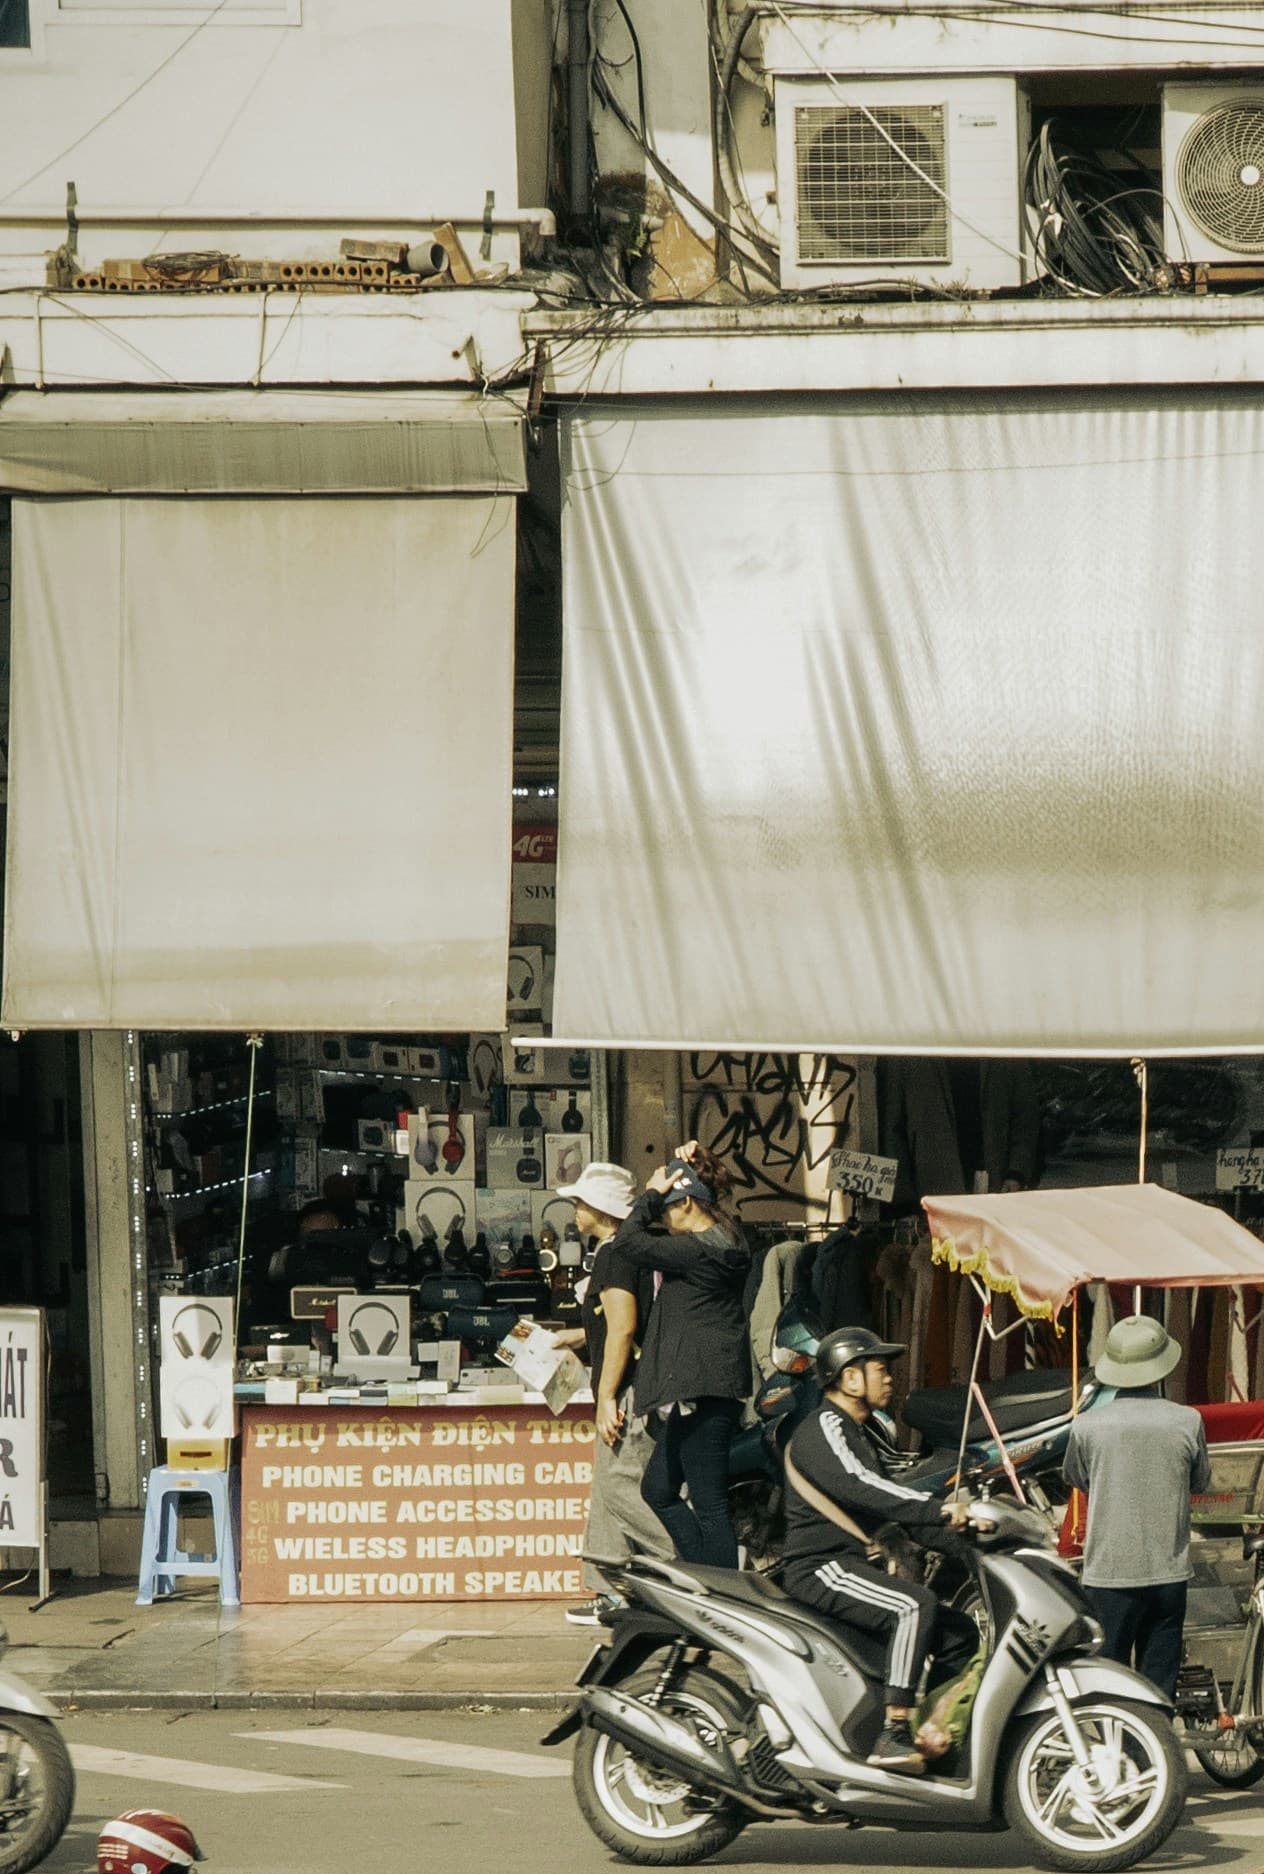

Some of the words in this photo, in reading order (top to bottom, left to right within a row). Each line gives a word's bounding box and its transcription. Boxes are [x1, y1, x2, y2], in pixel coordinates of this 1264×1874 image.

[512, 834, 544, 857] 4G
[525, 885, 556, 899] SIM
[836, 1171, 874, 1193] 350
[0, 1331, 27, 1418] ÁT
[255, 1422, 326, 1454] PHỤ
[336, 1416, 422, 1454] KIỆN
[432, 1415, 516, 1452] ĐIỆN
[262, 1464, 363, 1489] PHONE
[372, 1462, 526, 1488] CHARGING
[534, 1461, 593, 1485] CAB
[286, 1501, 388, 1525] PHONE
[274, 1537, 408, 1561] WIELESS
[415, 1534, 584, 1559] HEADPHON
[288, 1572, 455, 1596] BLUETOOTH
[464, 1570, 580, 1594] SPEAKE
